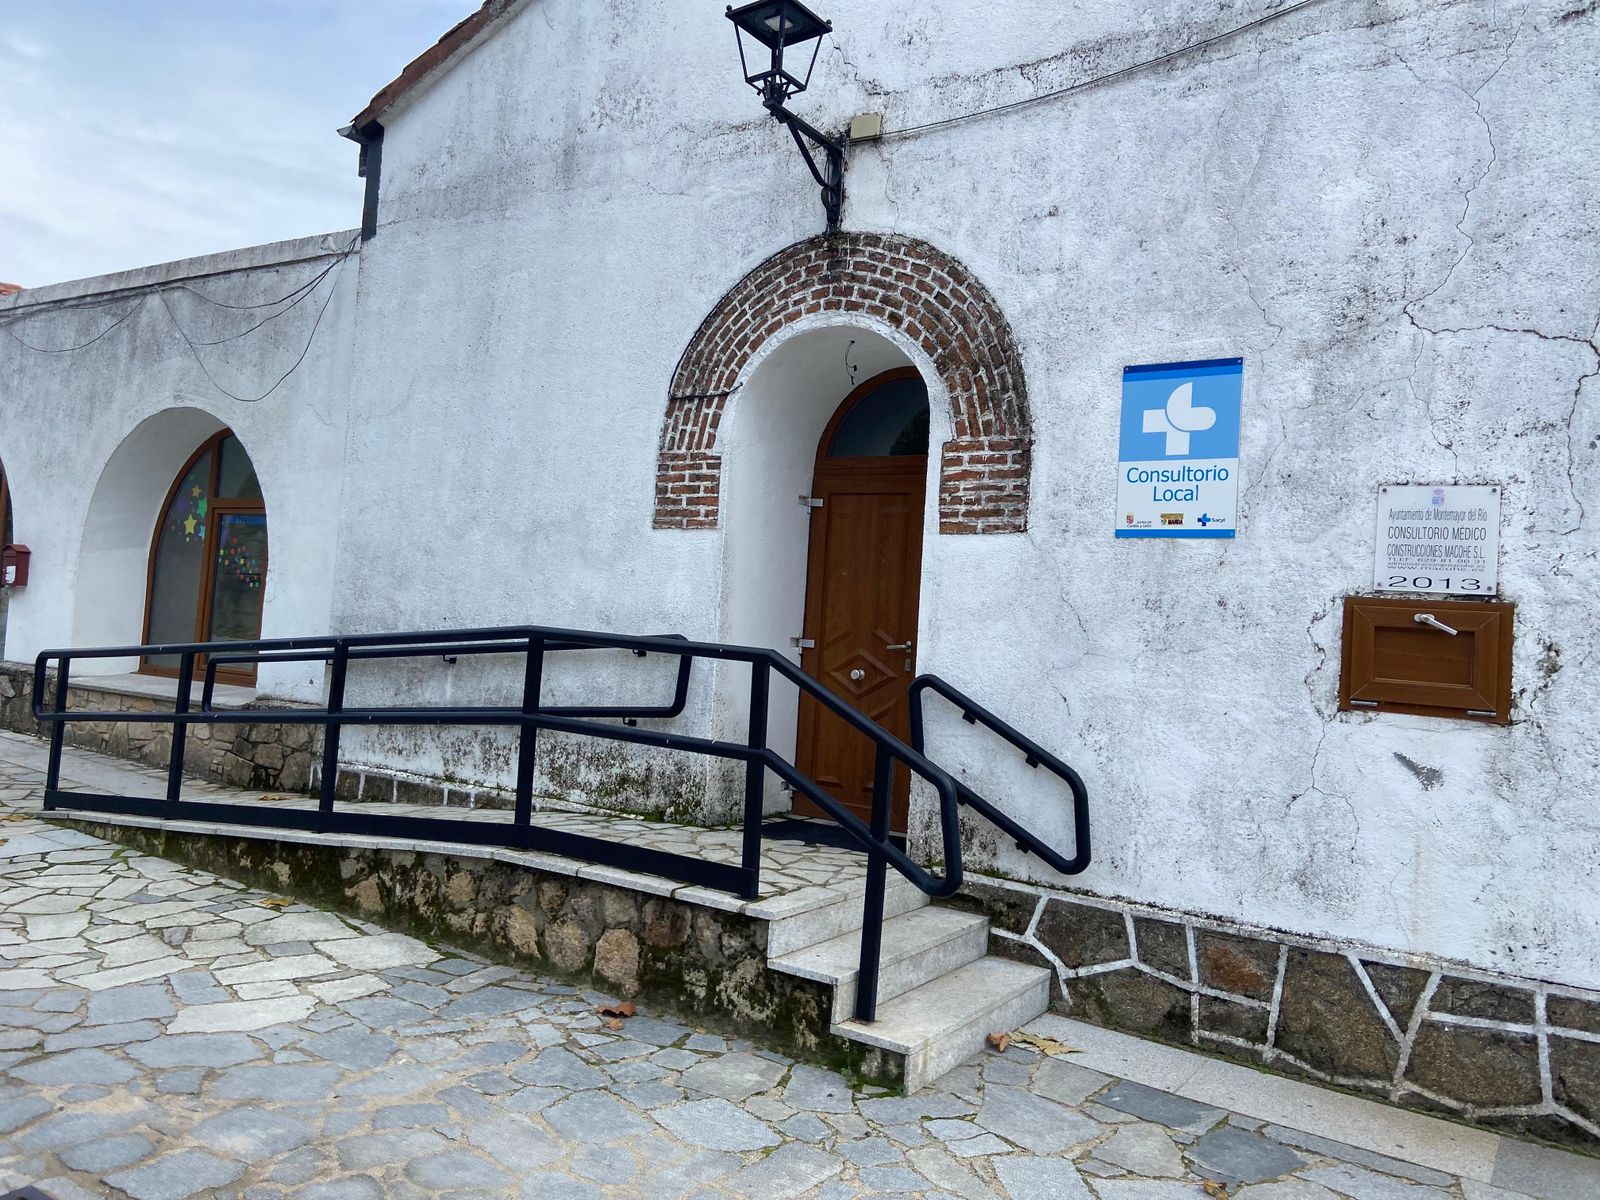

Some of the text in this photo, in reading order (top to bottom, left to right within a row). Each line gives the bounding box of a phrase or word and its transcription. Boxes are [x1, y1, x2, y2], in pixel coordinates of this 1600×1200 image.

[1127, 465, 1229, 483] Consultorio
[1153, 484, 1199, 501] Local
[1388, 508, 1424, 523] Ayuntamiento
[1425, 508, 1432, 521] de
[1433, 508, 1467, 523] Montemayor
[1468, 509, 1476, 521] del
[1388, 525, 1487, 541] CONSULTORIO MÉDICO
[1387, 543, 1443, 558] CONSTRUCCIONES
[1388, 576, 1481, 591] 2013
